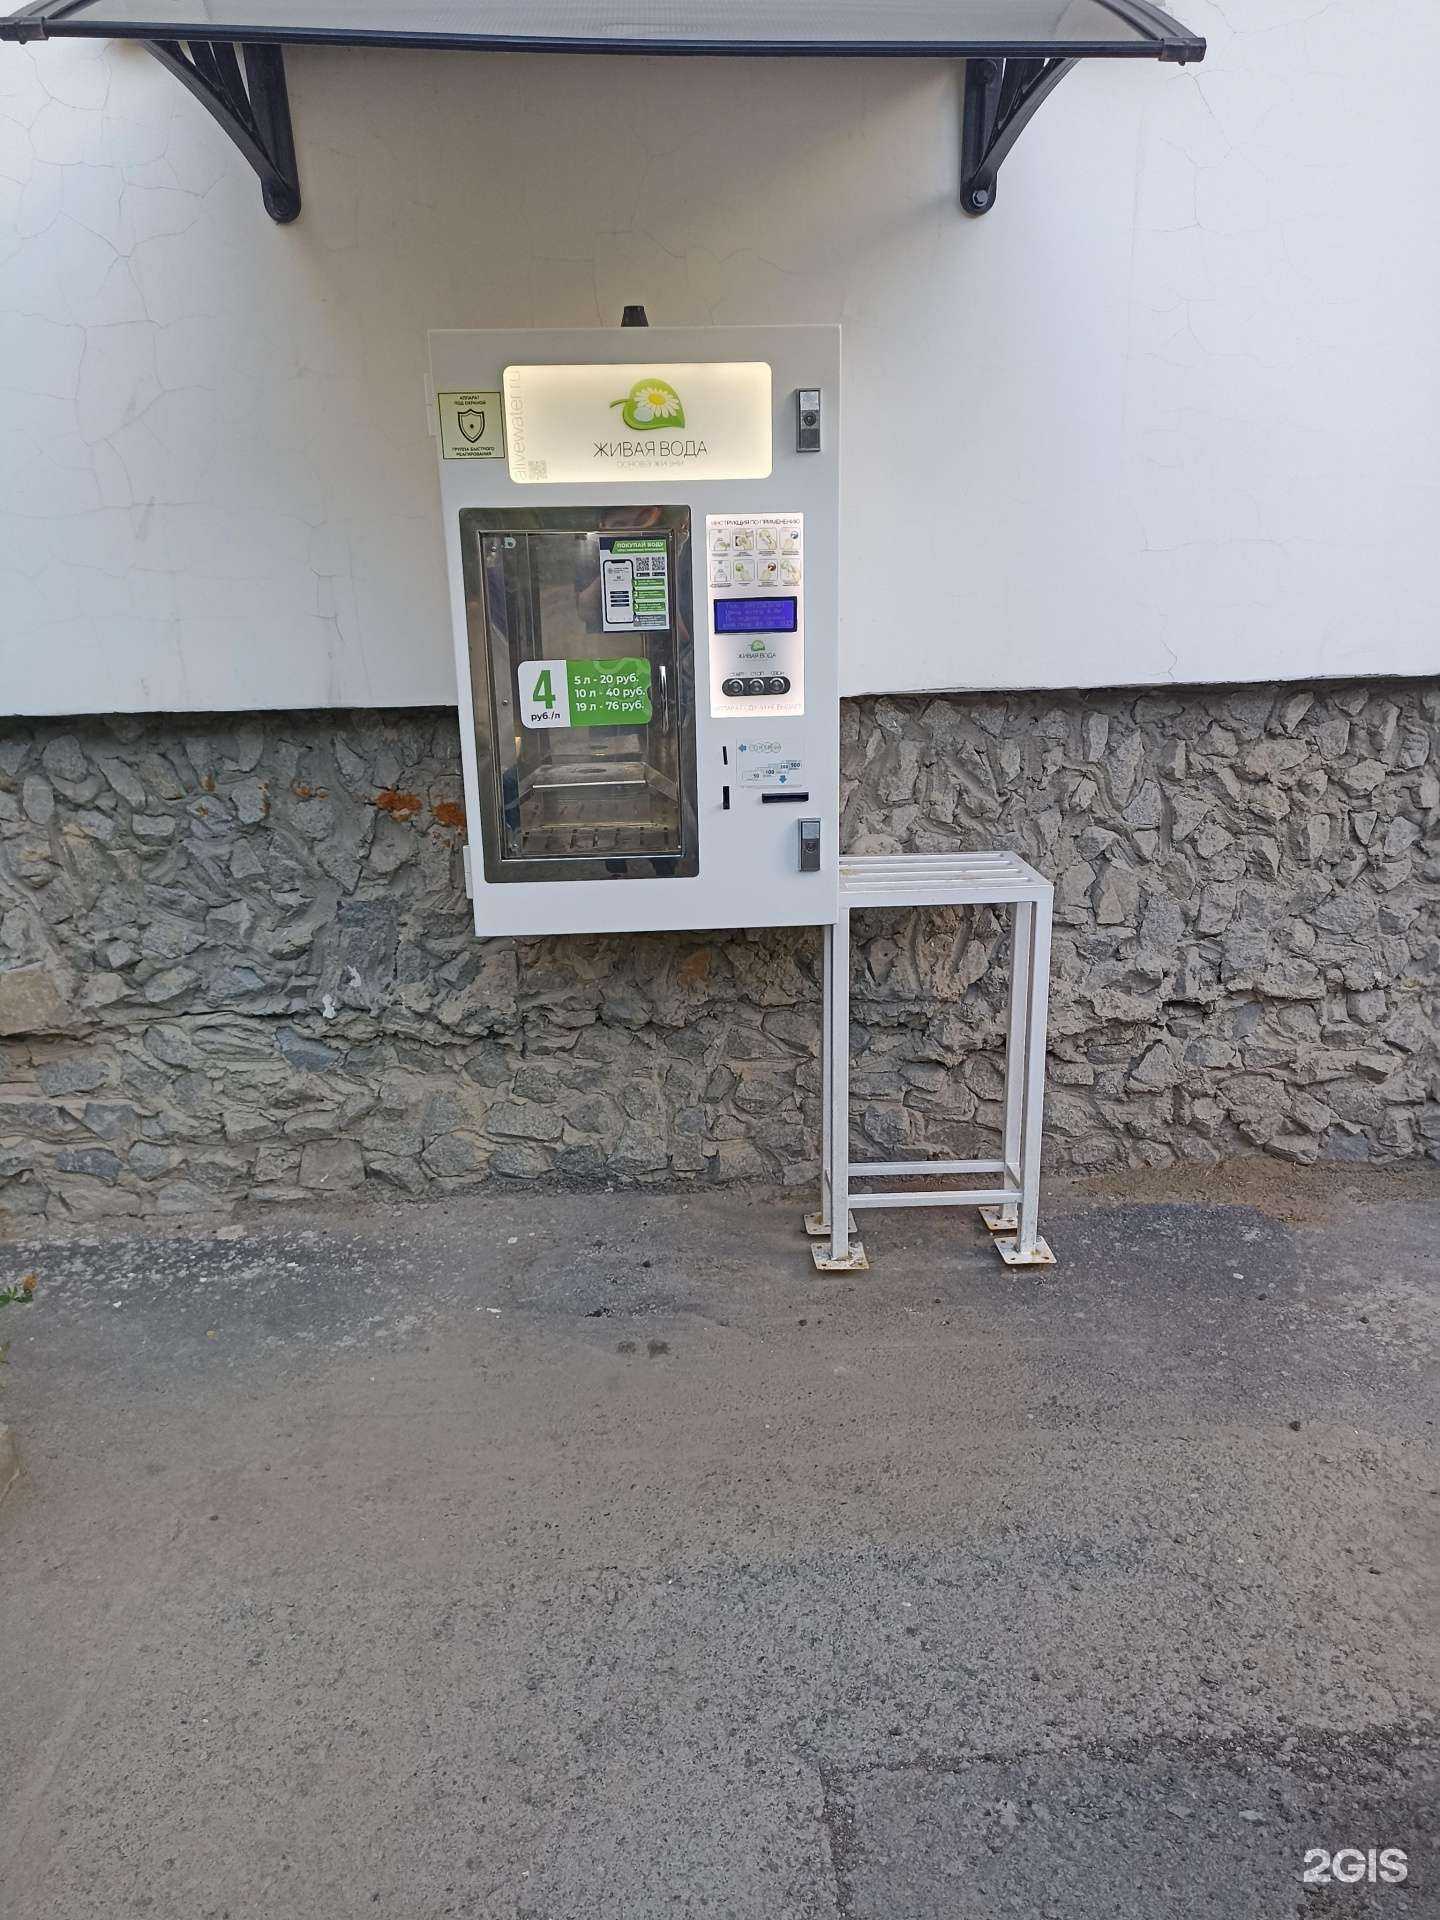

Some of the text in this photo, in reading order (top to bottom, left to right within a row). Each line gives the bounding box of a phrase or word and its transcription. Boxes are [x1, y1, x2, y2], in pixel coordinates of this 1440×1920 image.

[593, 440, 708, 458] ЖИВАЯ ВОДА
[574, 675, 581, 685] 5
[583, 676, 591, 684] л
[600, 674, 614, 684] 20
[616, 673, 639, 684] руб.
[532, 669, 556, 709] 4
[575, 689, 587, 698] 10
[605, 688, 620, 697] 40
[622, 686, 646, 698] руб.
[576, 702, 587, 712] 19
[589, 703, 596, 711] л
[605, 701, 619, 710] 76
[621, 700, 645, 711] руб.
[531, 711, 561, 722] руб./л
